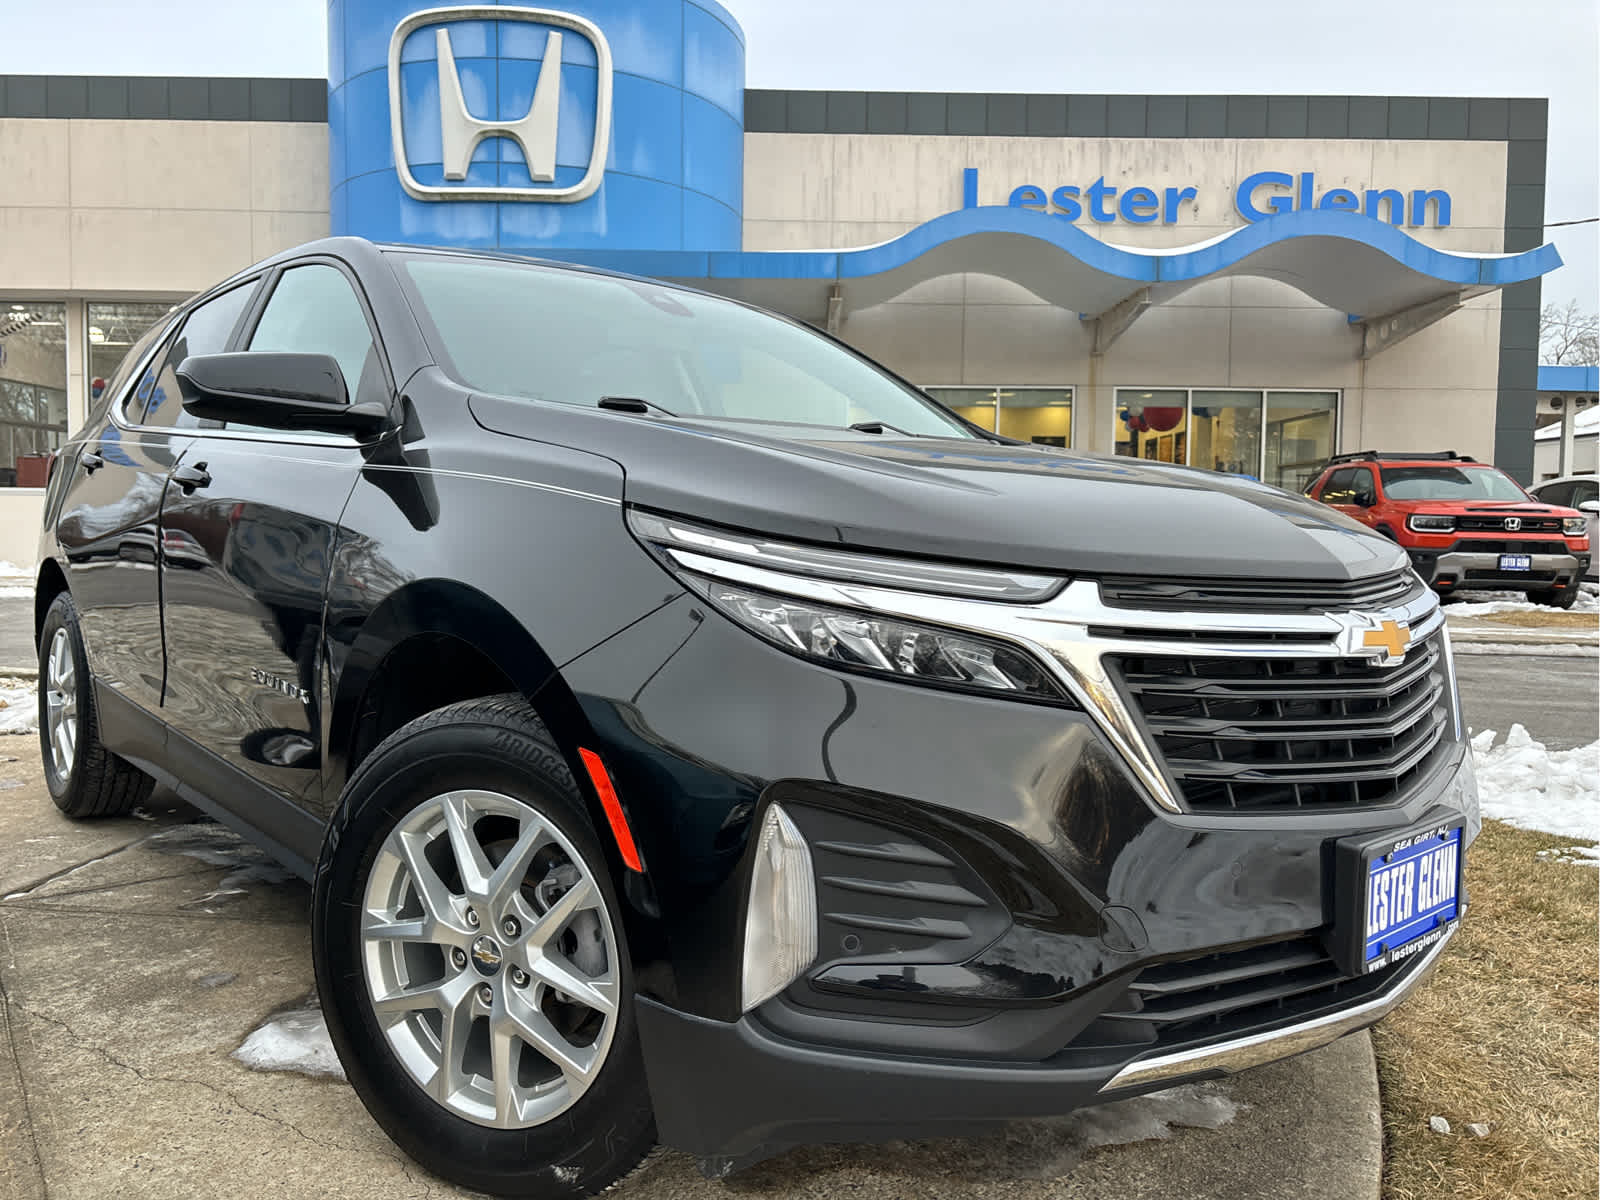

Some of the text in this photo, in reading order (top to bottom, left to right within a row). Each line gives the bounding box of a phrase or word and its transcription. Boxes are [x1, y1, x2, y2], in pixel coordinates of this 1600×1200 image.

[963, 168, 1452, 226] Lester Glenn
[1393, 838, 1412, 853] SEA
[1366, 843, 1457, 938] LESTER GLENN
[1391, 930, 1441, 962] lesterglenn
